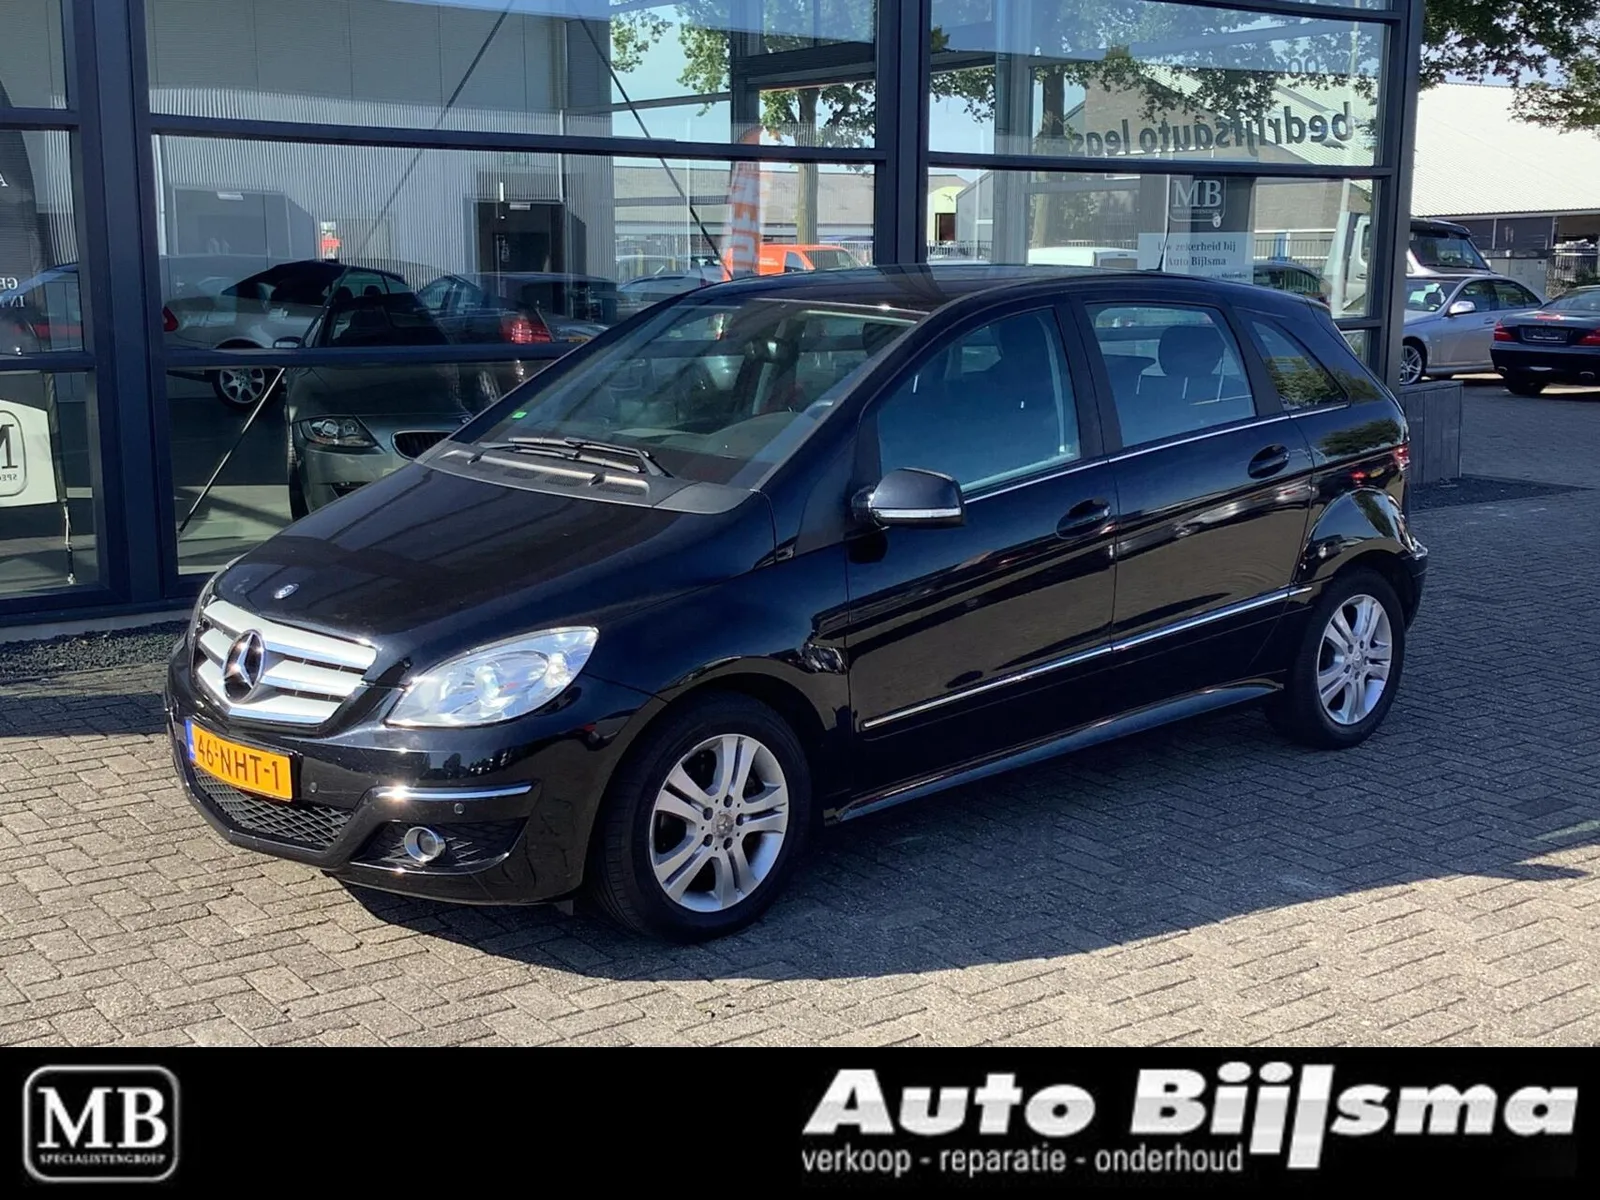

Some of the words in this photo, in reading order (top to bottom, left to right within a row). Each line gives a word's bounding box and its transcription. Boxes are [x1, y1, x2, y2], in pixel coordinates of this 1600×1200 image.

[1172, 180, 1222, 207] MB
[1175, 241, 1221, 252] zekerheid
[1223, 241, 1236, 253] bij
[1167, 257, 1189, 267] Auto
[1191, 256, 1227, 268] Bijlsma
[198, 734, 280, 791] 46-NHT-1
